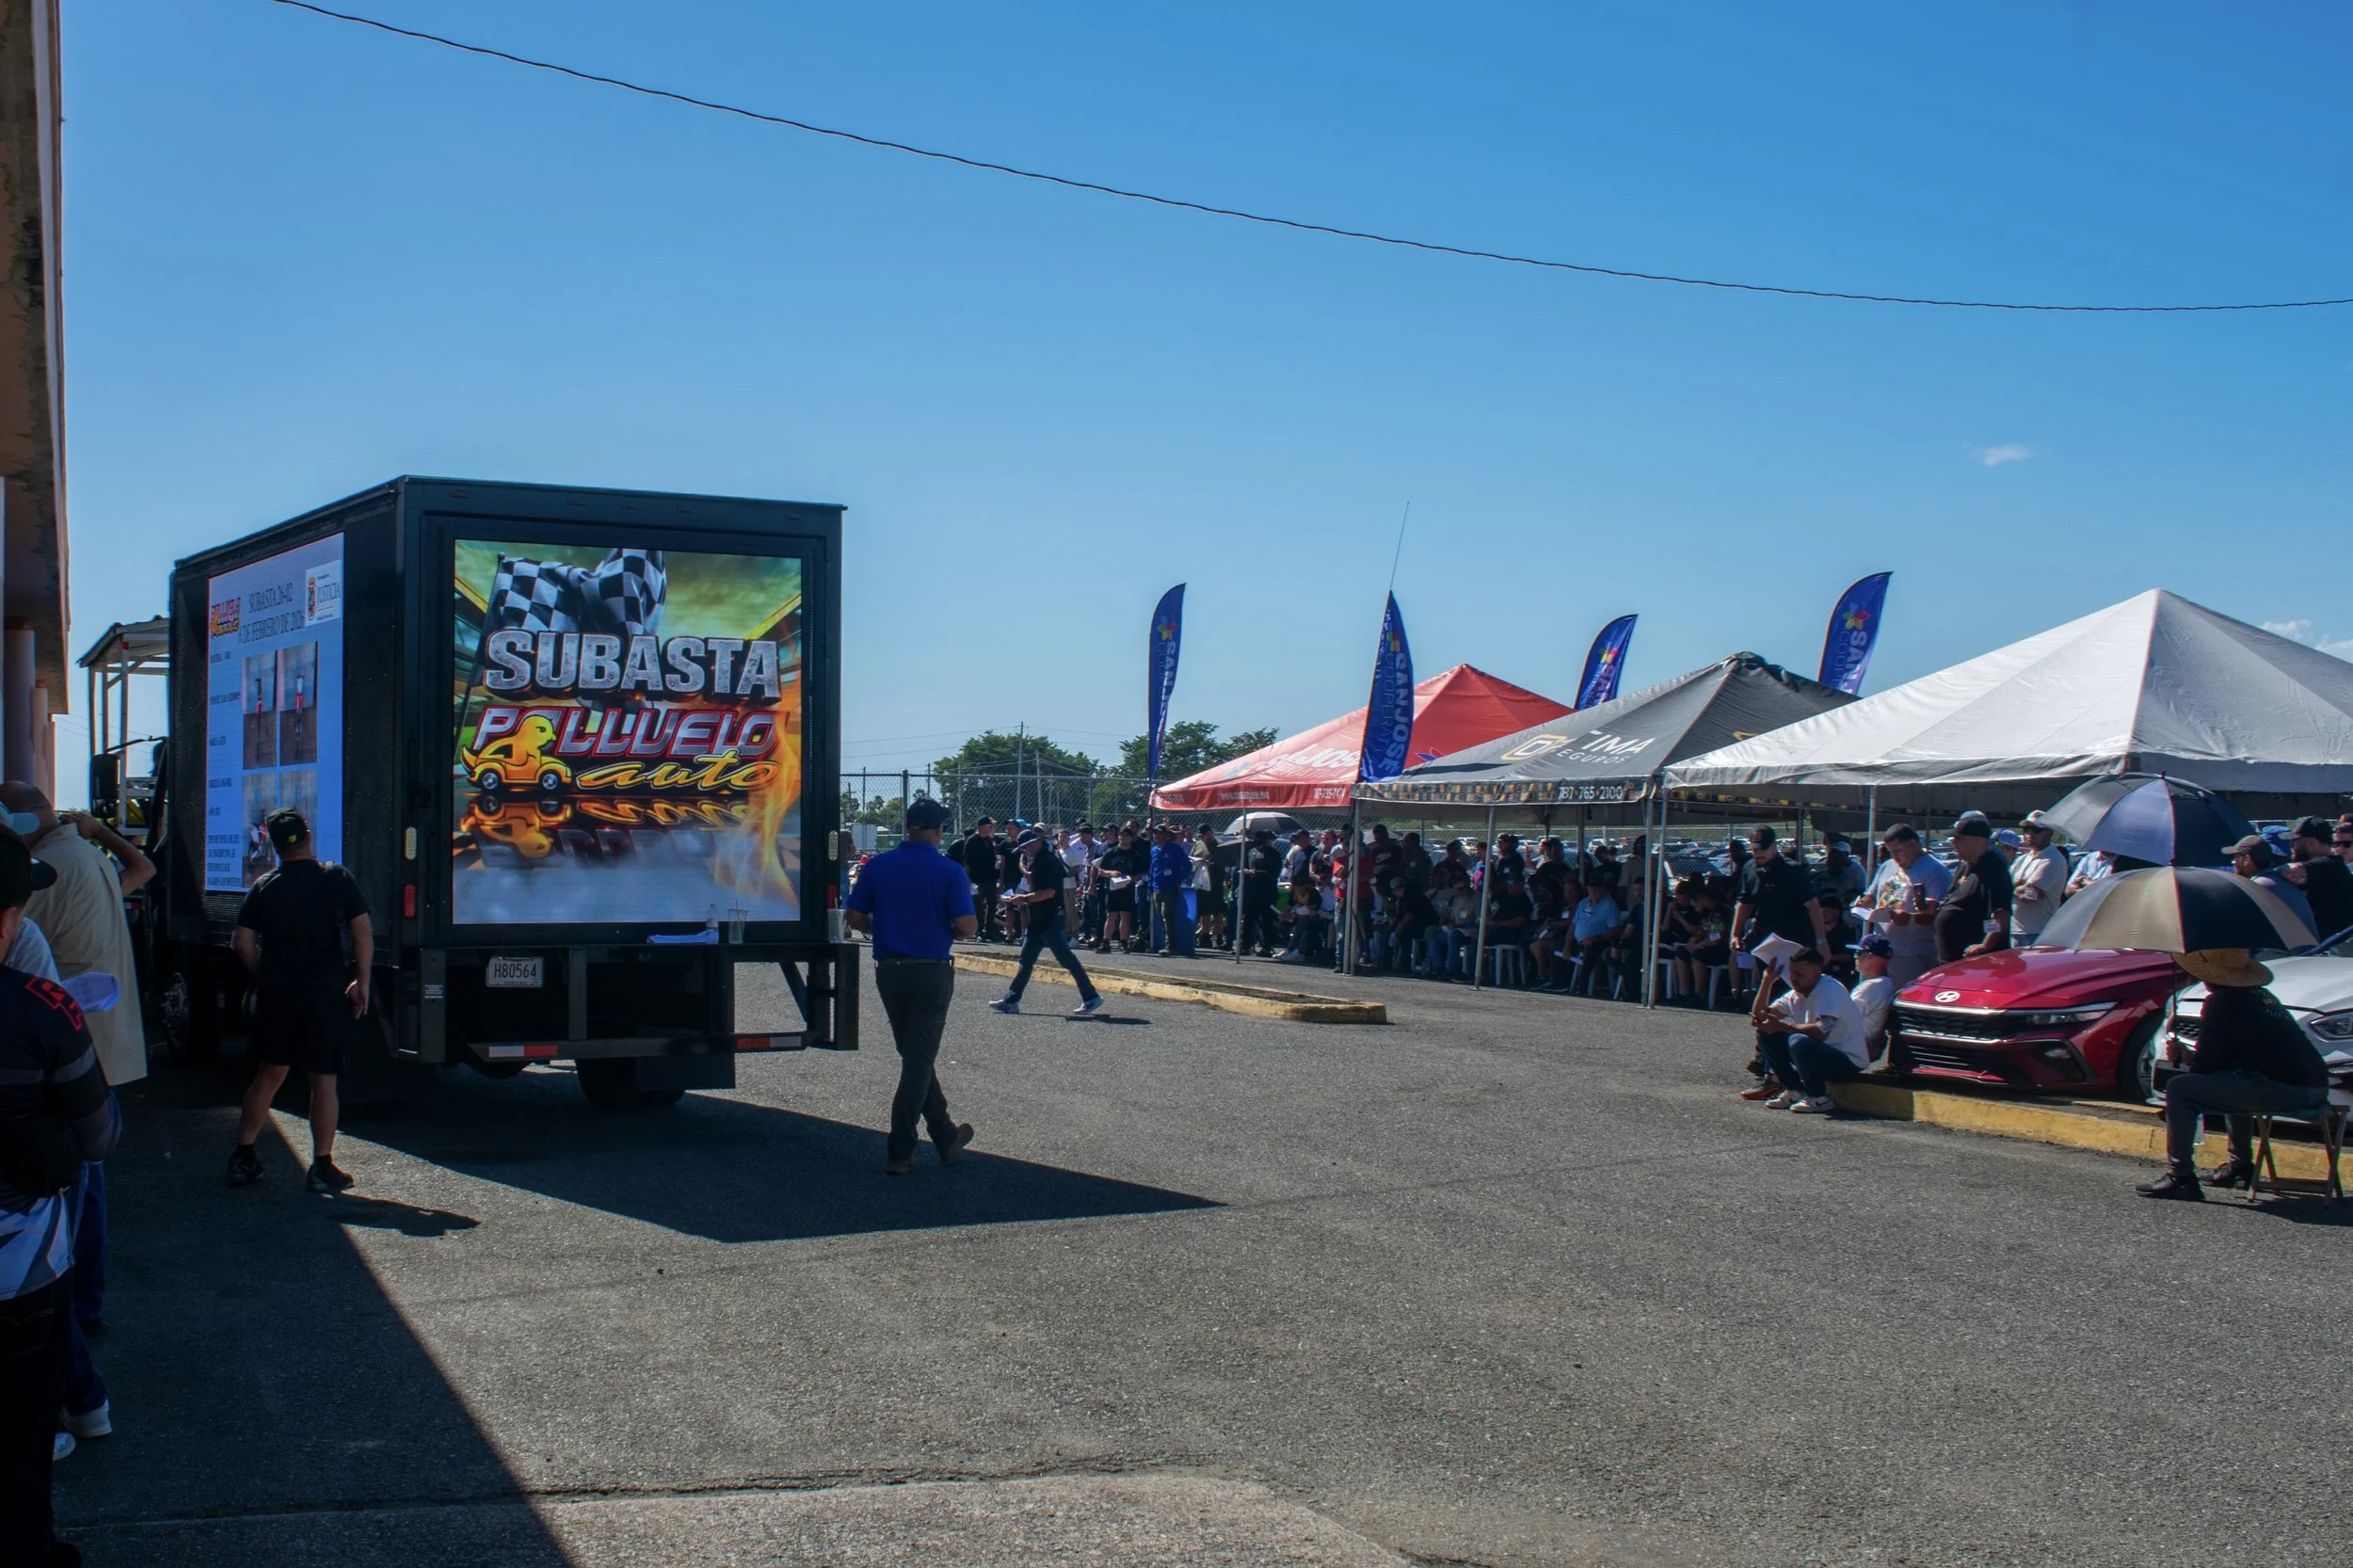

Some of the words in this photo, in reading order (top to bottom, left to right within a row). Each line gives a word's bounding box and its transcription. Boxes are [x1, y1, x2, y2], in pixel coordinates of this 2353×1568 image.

[248, 587, 277, 614] SUBASTA
[484, 628, 781, 700] SUBASTA
[1556, 748, 1630, 764] EGUROS
[575, 748, 784, 791] auto
[1578, 786, 1595, 800] 765
[1600, 785, 1623, 799] 2100
[494, 963, 536, 978] H80564
